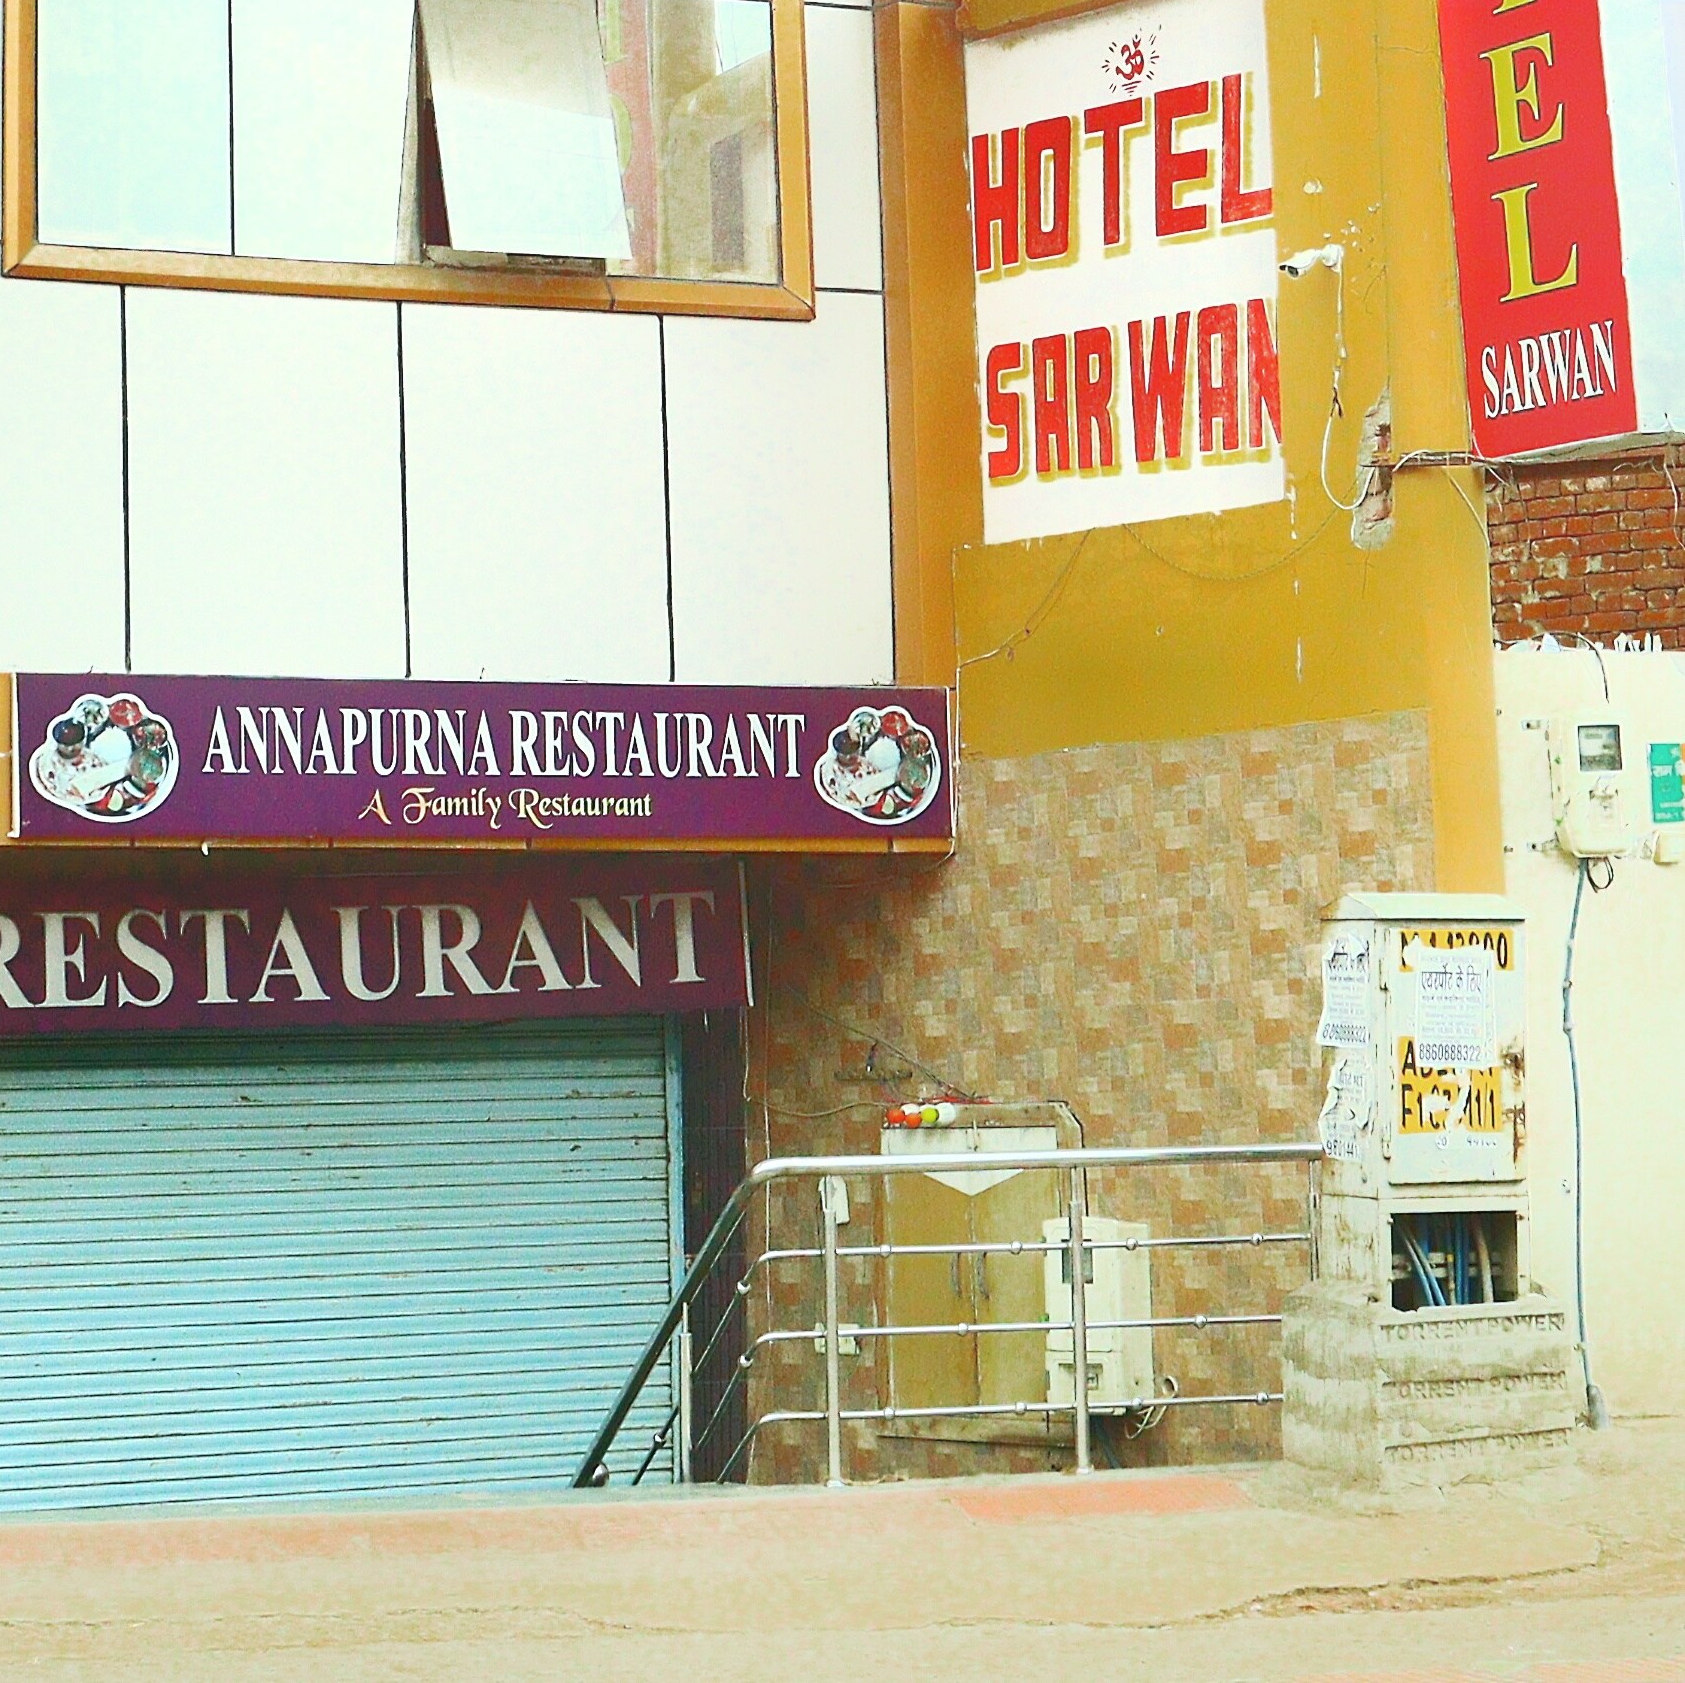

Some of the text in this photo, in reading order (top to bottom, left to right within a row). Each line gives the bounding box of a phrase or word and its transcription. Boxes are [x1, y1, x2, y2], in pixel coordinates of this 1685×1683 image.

[972, 73, 1273, 271] HOTEL
[987, 299, 1282, 479] SARWAN
[1481, 320, 1617, 419] SARWAN
[201, 705, 806, 781] ANNAPURNA RESTAURANT
[358, 787, 652, 830] A Family Restaurant
